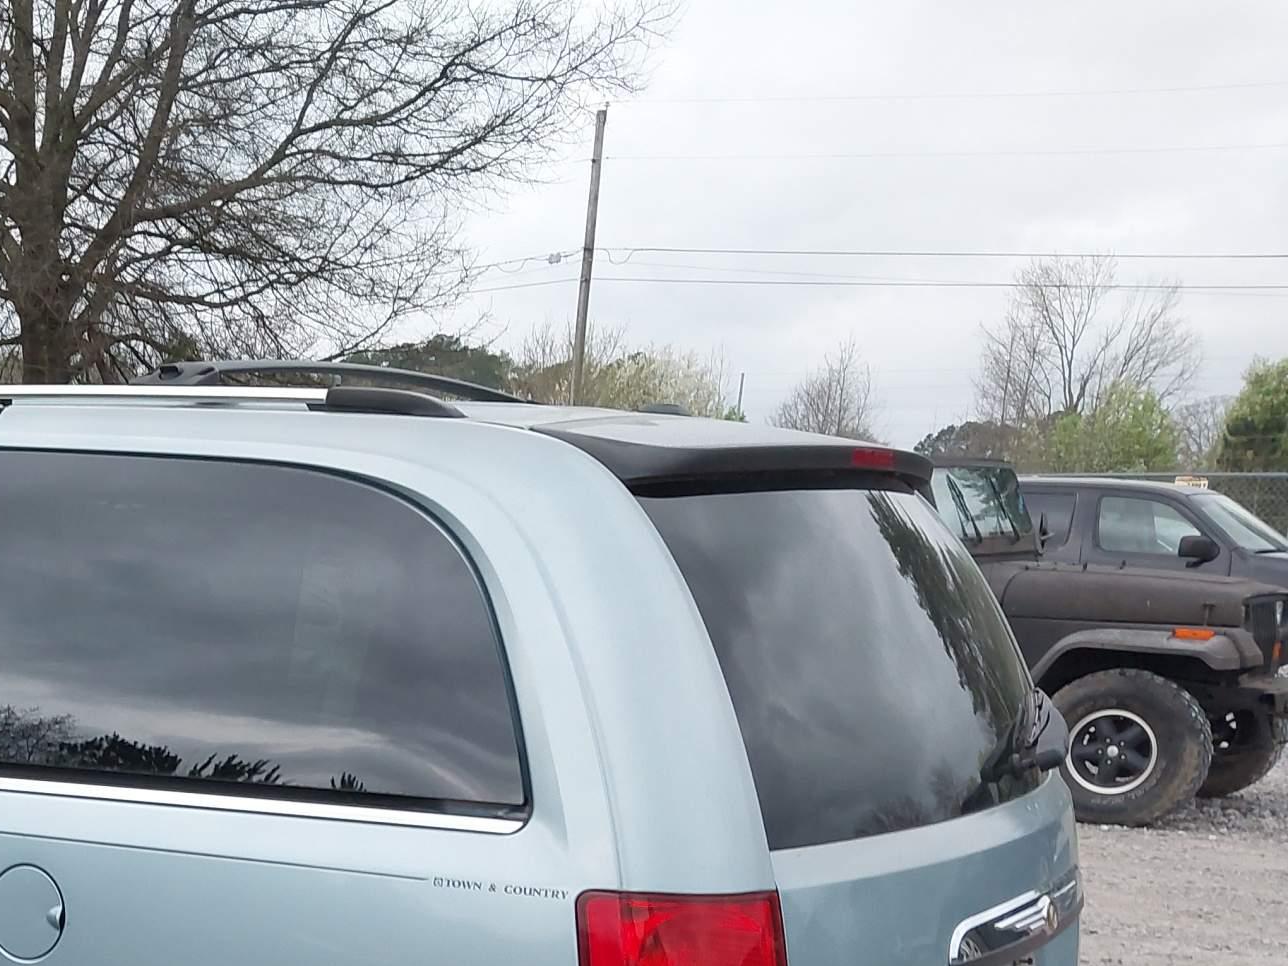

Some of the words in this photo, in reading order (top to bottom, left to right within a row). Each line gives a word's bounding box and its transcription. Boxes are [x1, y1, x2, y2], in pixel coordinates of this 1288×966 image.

[446, 878, 482, 890] TOWN
[488, 883, 497, 892] &
[504, 885, 568, 899] COUNTRY
